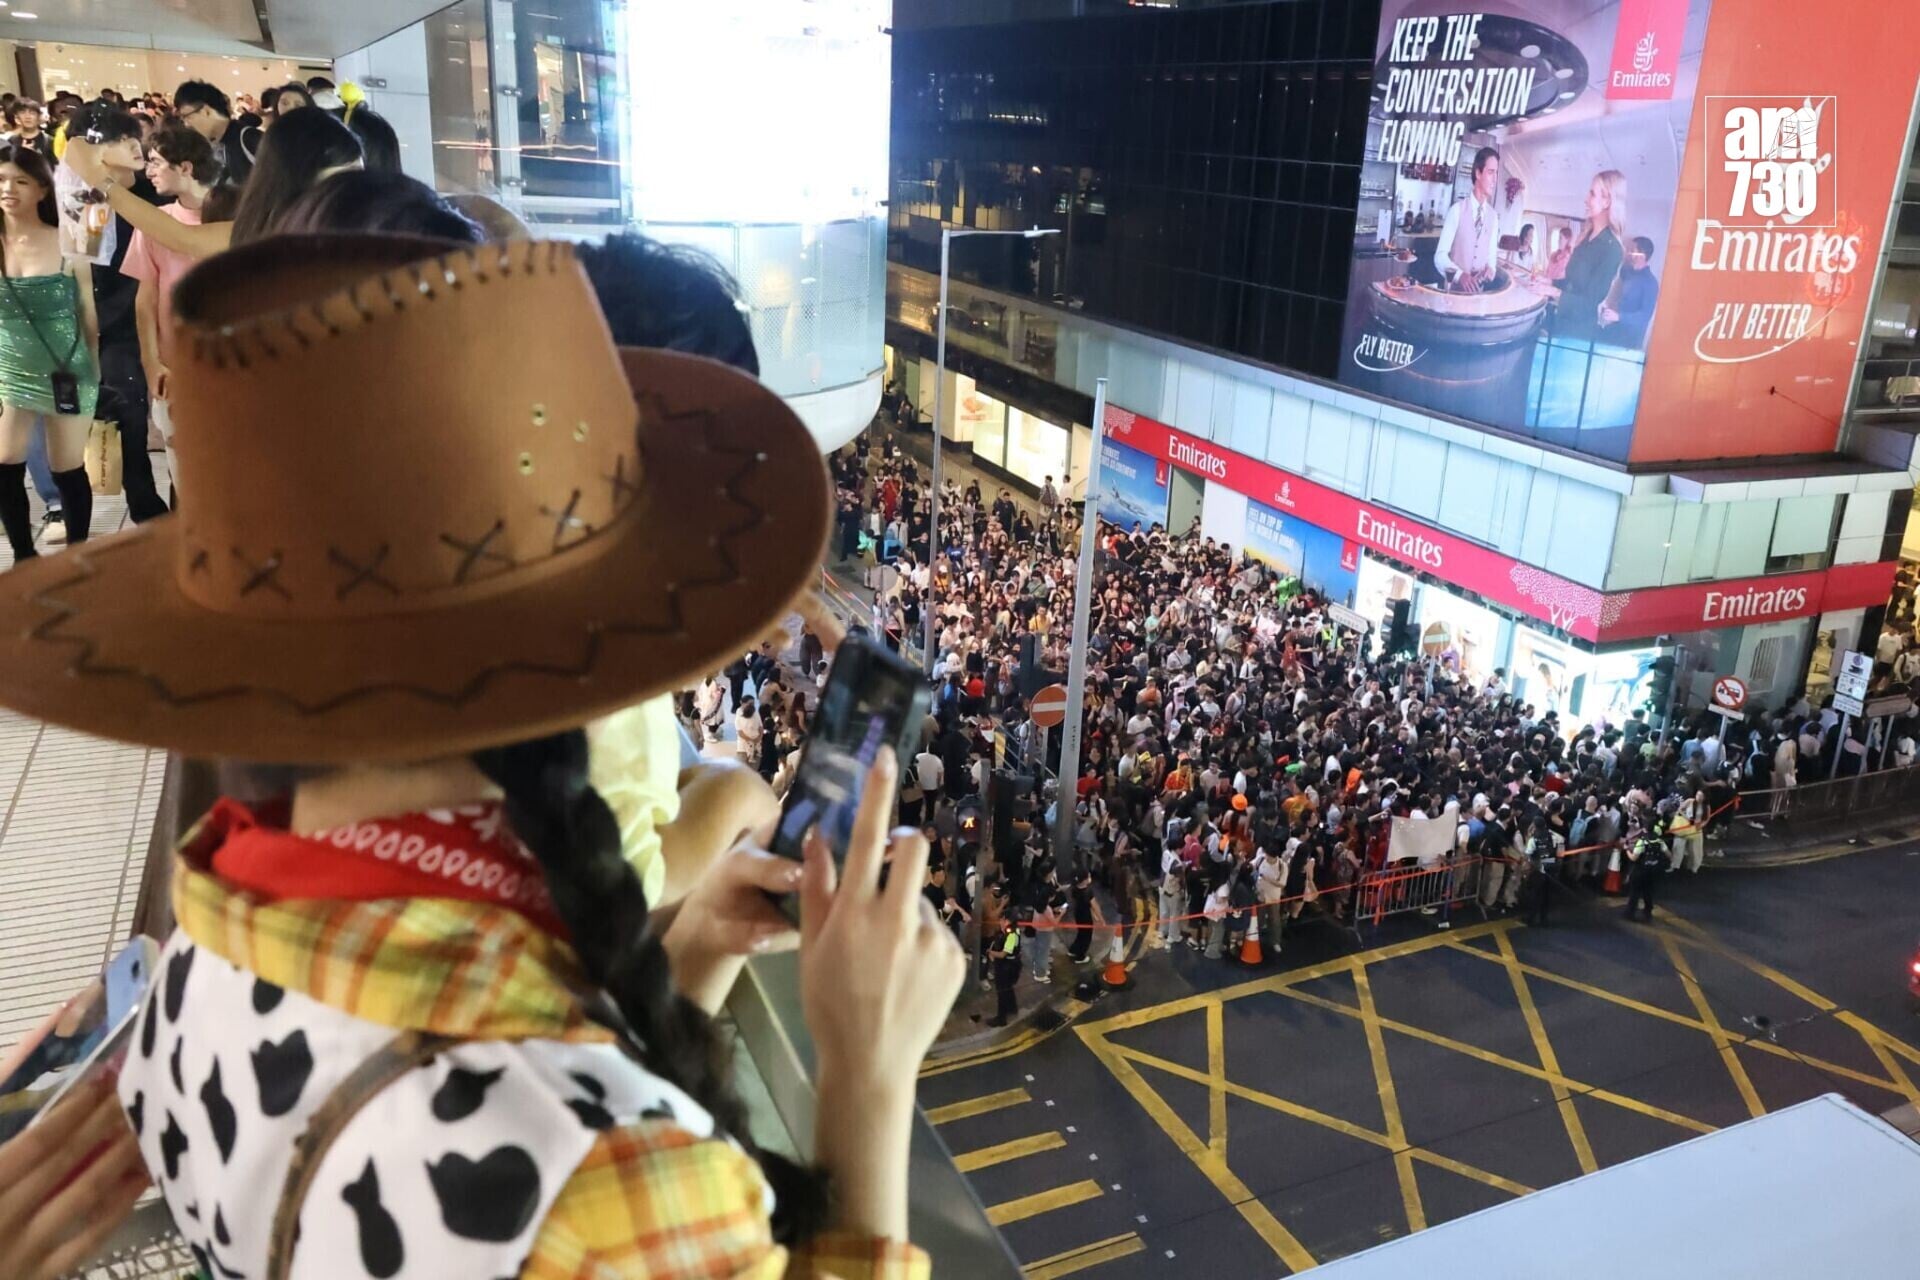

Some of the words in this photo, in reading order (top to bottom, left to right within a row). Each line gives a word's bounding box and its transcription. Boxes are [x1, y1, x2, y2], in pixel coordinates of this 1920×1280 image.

[1389, 16, 1440, 62] KEEP
[1441, 14, 1483, 61] THE
[1384, 67, 1536, 115] CONVERSATION
[1612, 70, 1671, 87] Emirates
[1377, 119, 1464, 166] FLOWING
[1691, 219, 1860, 273] Emirates
[1707, 303, 1744, 339] FLY
[1742, 303, 1812, 339] BETTER
[1360, 333, 1378, 357] FLY
[1377, 338, 1414, 365] BETTER
[1168, 434, 1226, 478] Emirates
[1357, 509, 1443, 567] Emirates
[1702, 586, 1807, 621] Emirates
